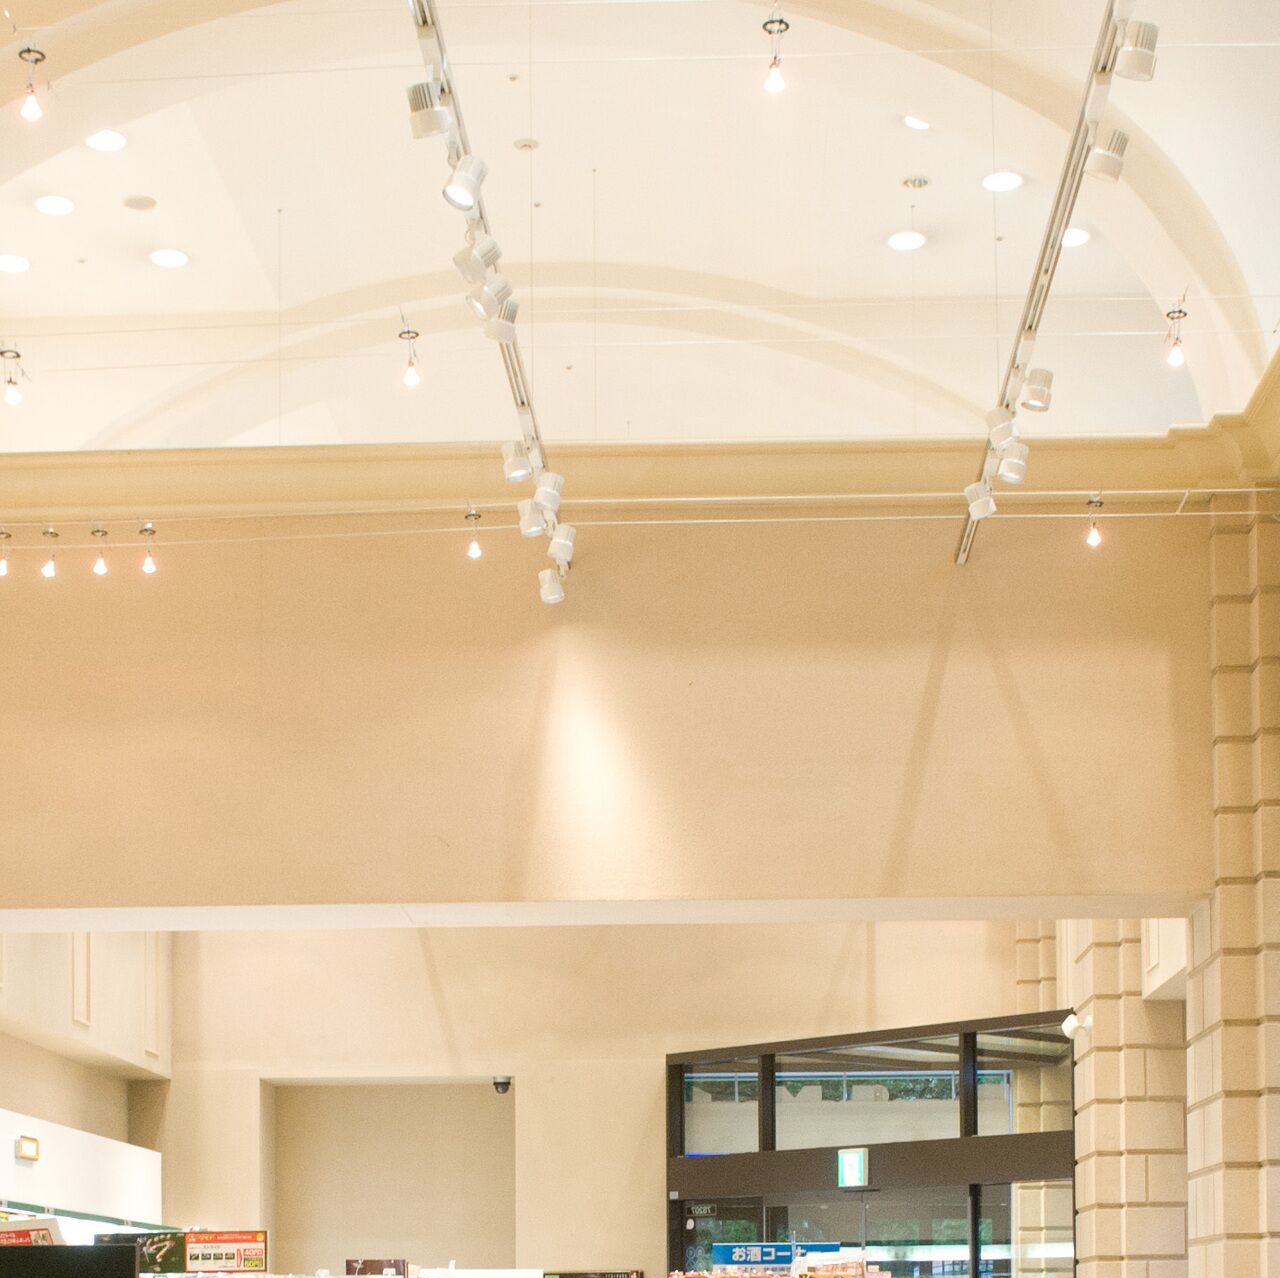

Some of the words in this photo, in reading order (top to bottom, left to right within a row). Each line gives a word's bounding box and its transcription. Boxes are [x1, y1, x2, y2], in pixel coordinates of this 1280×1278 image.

[732, 1246, 814, 1262] お酒コーナ
